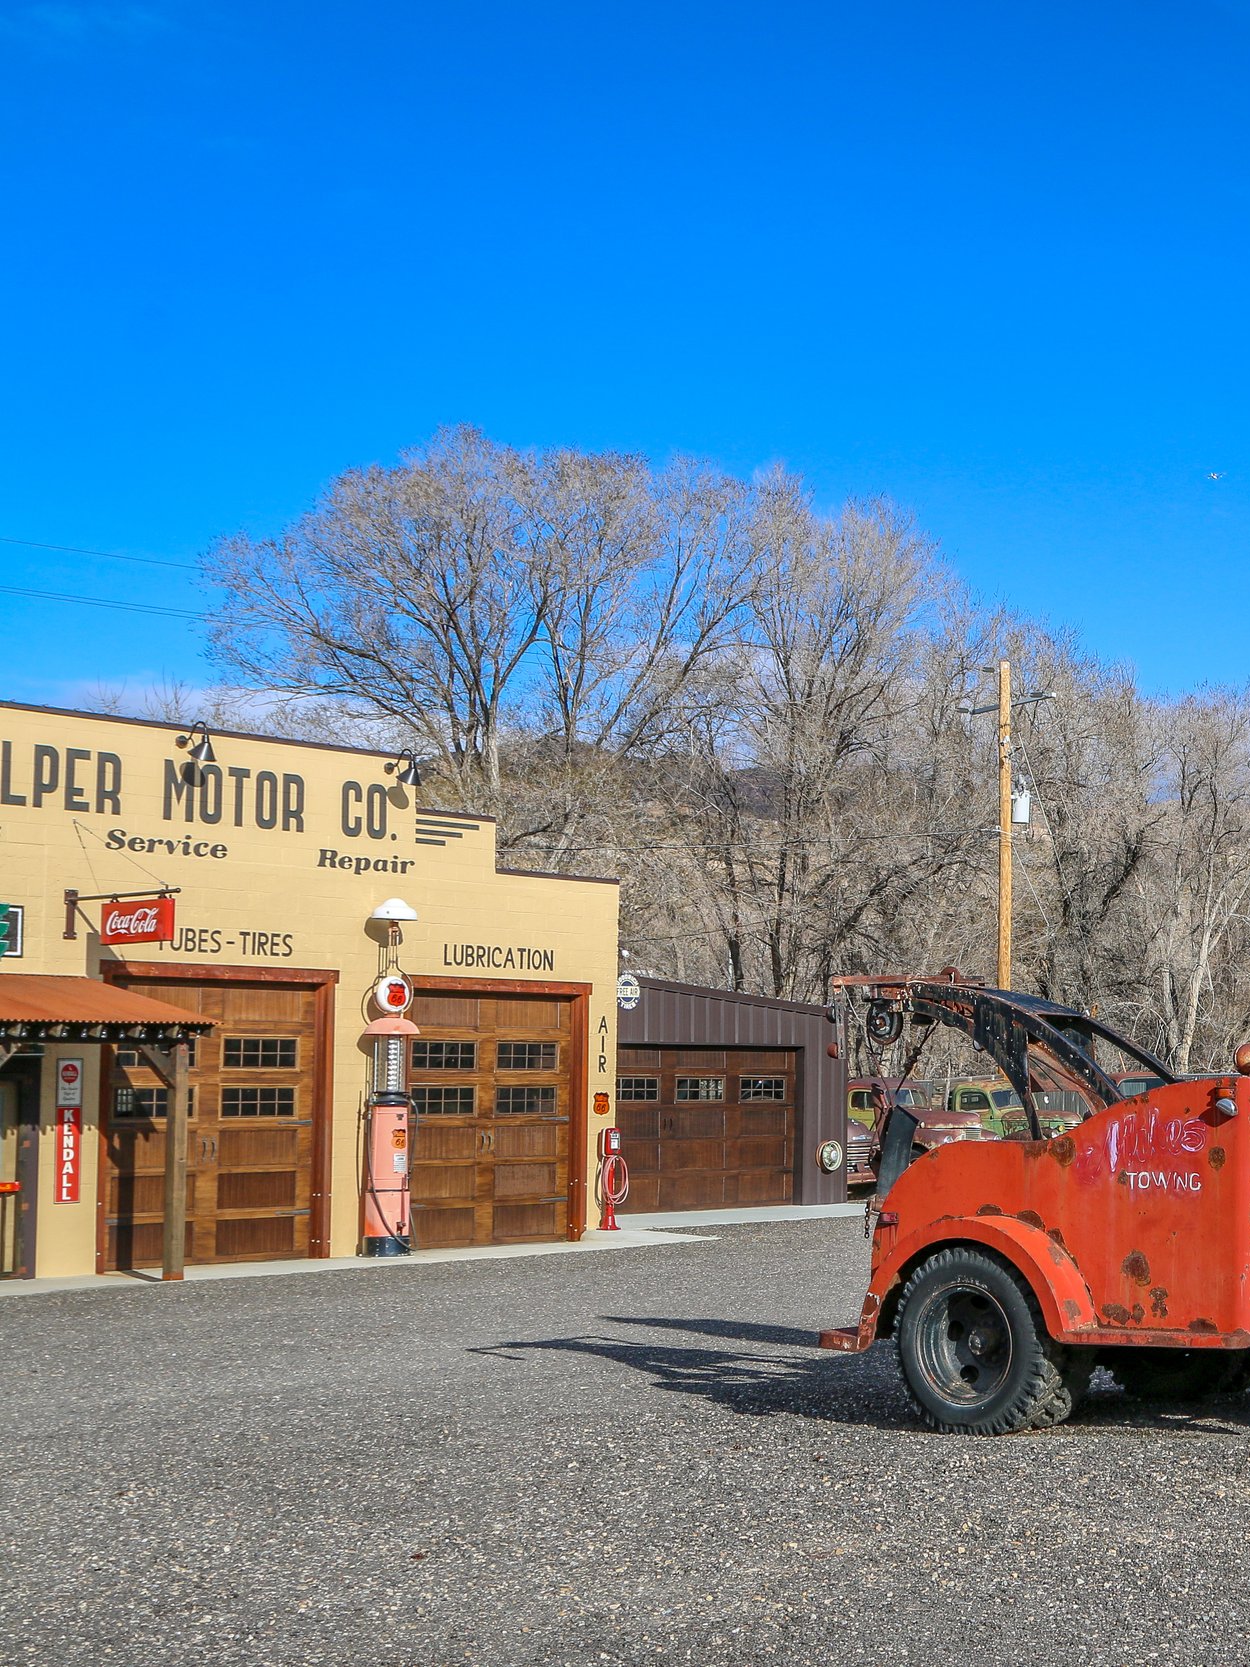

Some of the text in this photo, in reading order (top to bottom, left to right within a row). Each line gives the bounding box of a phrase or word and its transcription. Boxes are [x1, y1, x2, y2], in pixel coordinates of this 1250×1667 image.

[1, 740, 398, 841] LPER MOTOR CO.
[105, 828, 229, 859] Service
[317, 848, 416, 875] Repair
[106, 907, 160, 936] Coca-Cola
[443, 943, 555, 971] LUBRICATION
[597, 1015, 609, 1074] AIR
[596, 1103, 607, 1112] 66
[62, 1109, 75, 1201] KENDALL
[1126, 1171, 1202, 1191] TOWING
